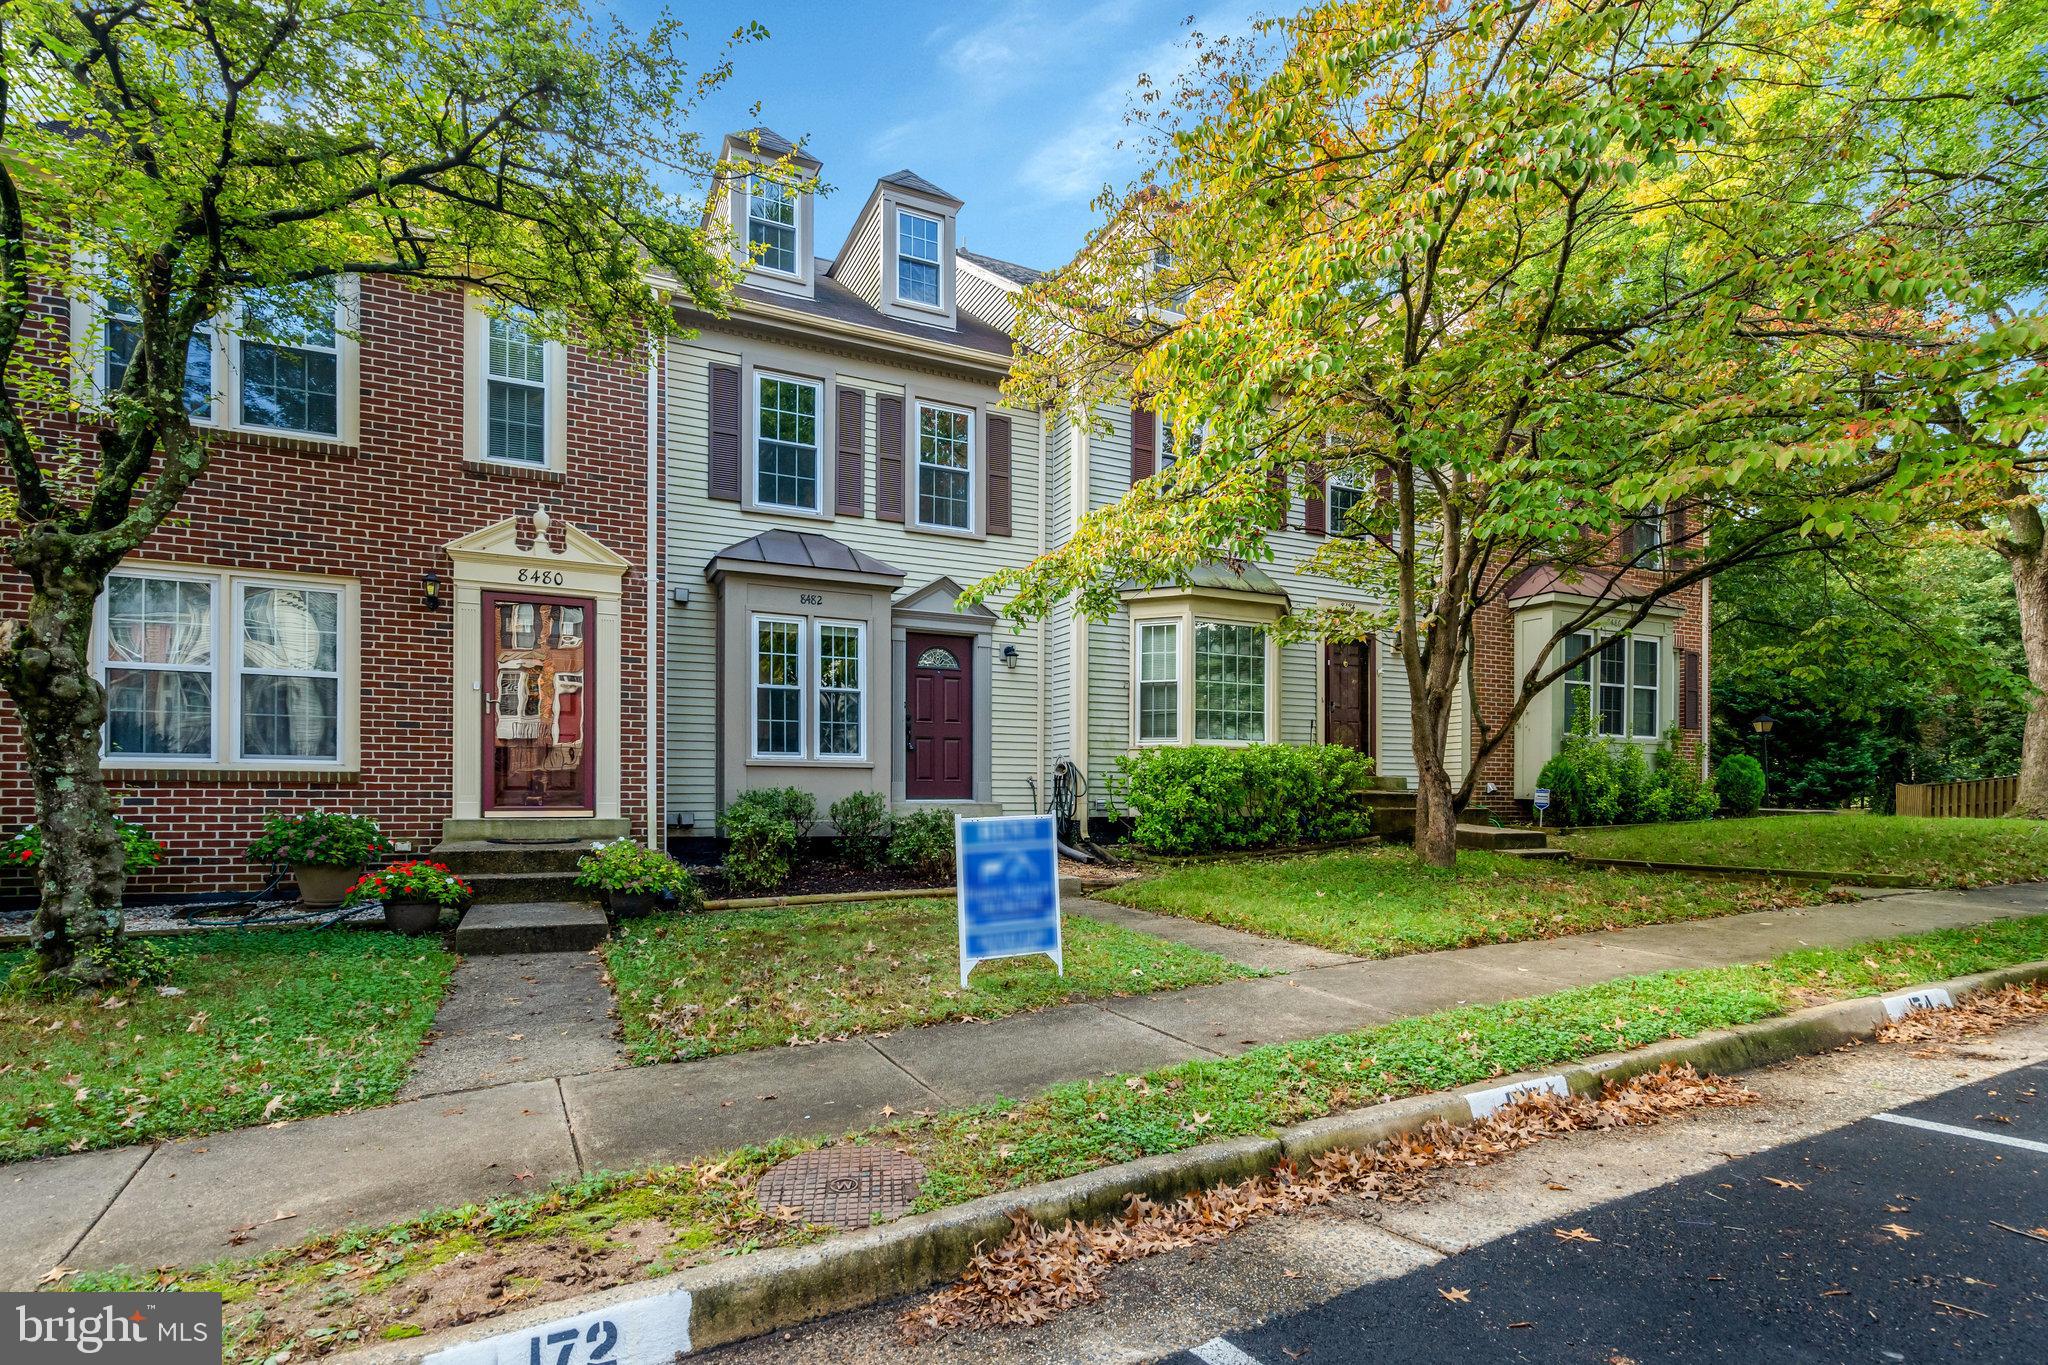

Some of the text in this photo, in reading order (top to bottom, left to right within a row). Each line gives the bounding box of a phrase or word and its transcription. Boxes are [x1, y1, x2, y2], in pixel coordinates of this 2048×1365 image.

[518, 568, 564, 586] 8480
[800, 593, 823, 606] 8482
[530, 1320, 618, 1365] 172
